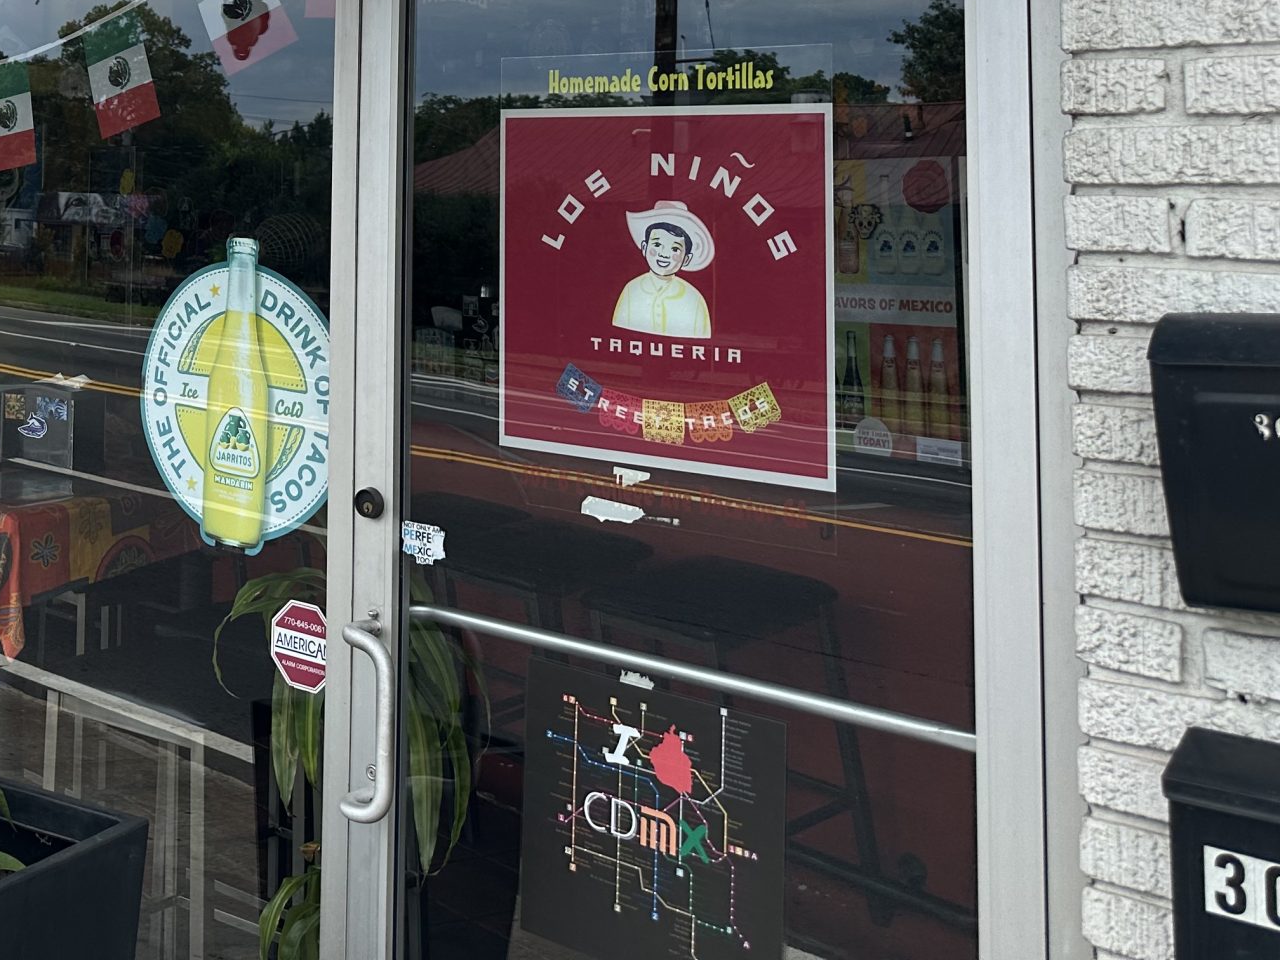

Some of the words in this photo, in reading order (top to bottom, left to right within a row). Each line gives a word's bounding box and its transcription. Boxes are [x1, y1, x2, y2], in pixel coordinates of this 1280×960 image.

[548, 68, 641, 94] Homemade
[647, 65, 689, 92] Corn
[695, 61, 774, 91] Tortillas
[541, 169, 612, 250] LOS
[650, 152, 798, 260] NIÑOS
[835, 296, 876, 311] AVORS
[879, 298, 895, 311] OF
[898, 299, 953, 313] MEXICO
[260, 289, 327, 370] DRINK
[153, 292, 211, 407] OFFICIAL
[590, 337, 742, 364] TAQUERIA
[180, 382, 200, 400] Ice
[314, 375, 329, 415] OF
[567, 377, 663, 430] STREET
[684, 398, 769, 429] TACOS
[275, 399, 304, 419] Cold
[157, 416, 186, 479] THE
[857, 436, 890, 449] TODAY!
[216, 451, 252, 467] JARRITOS
[270, 432, 329, 513] TACOS
[214, 474, 253, 491] MANDARIN
[404, 528, 432, 543] PERFE
[404, 543, 433, 558] MEXIC
